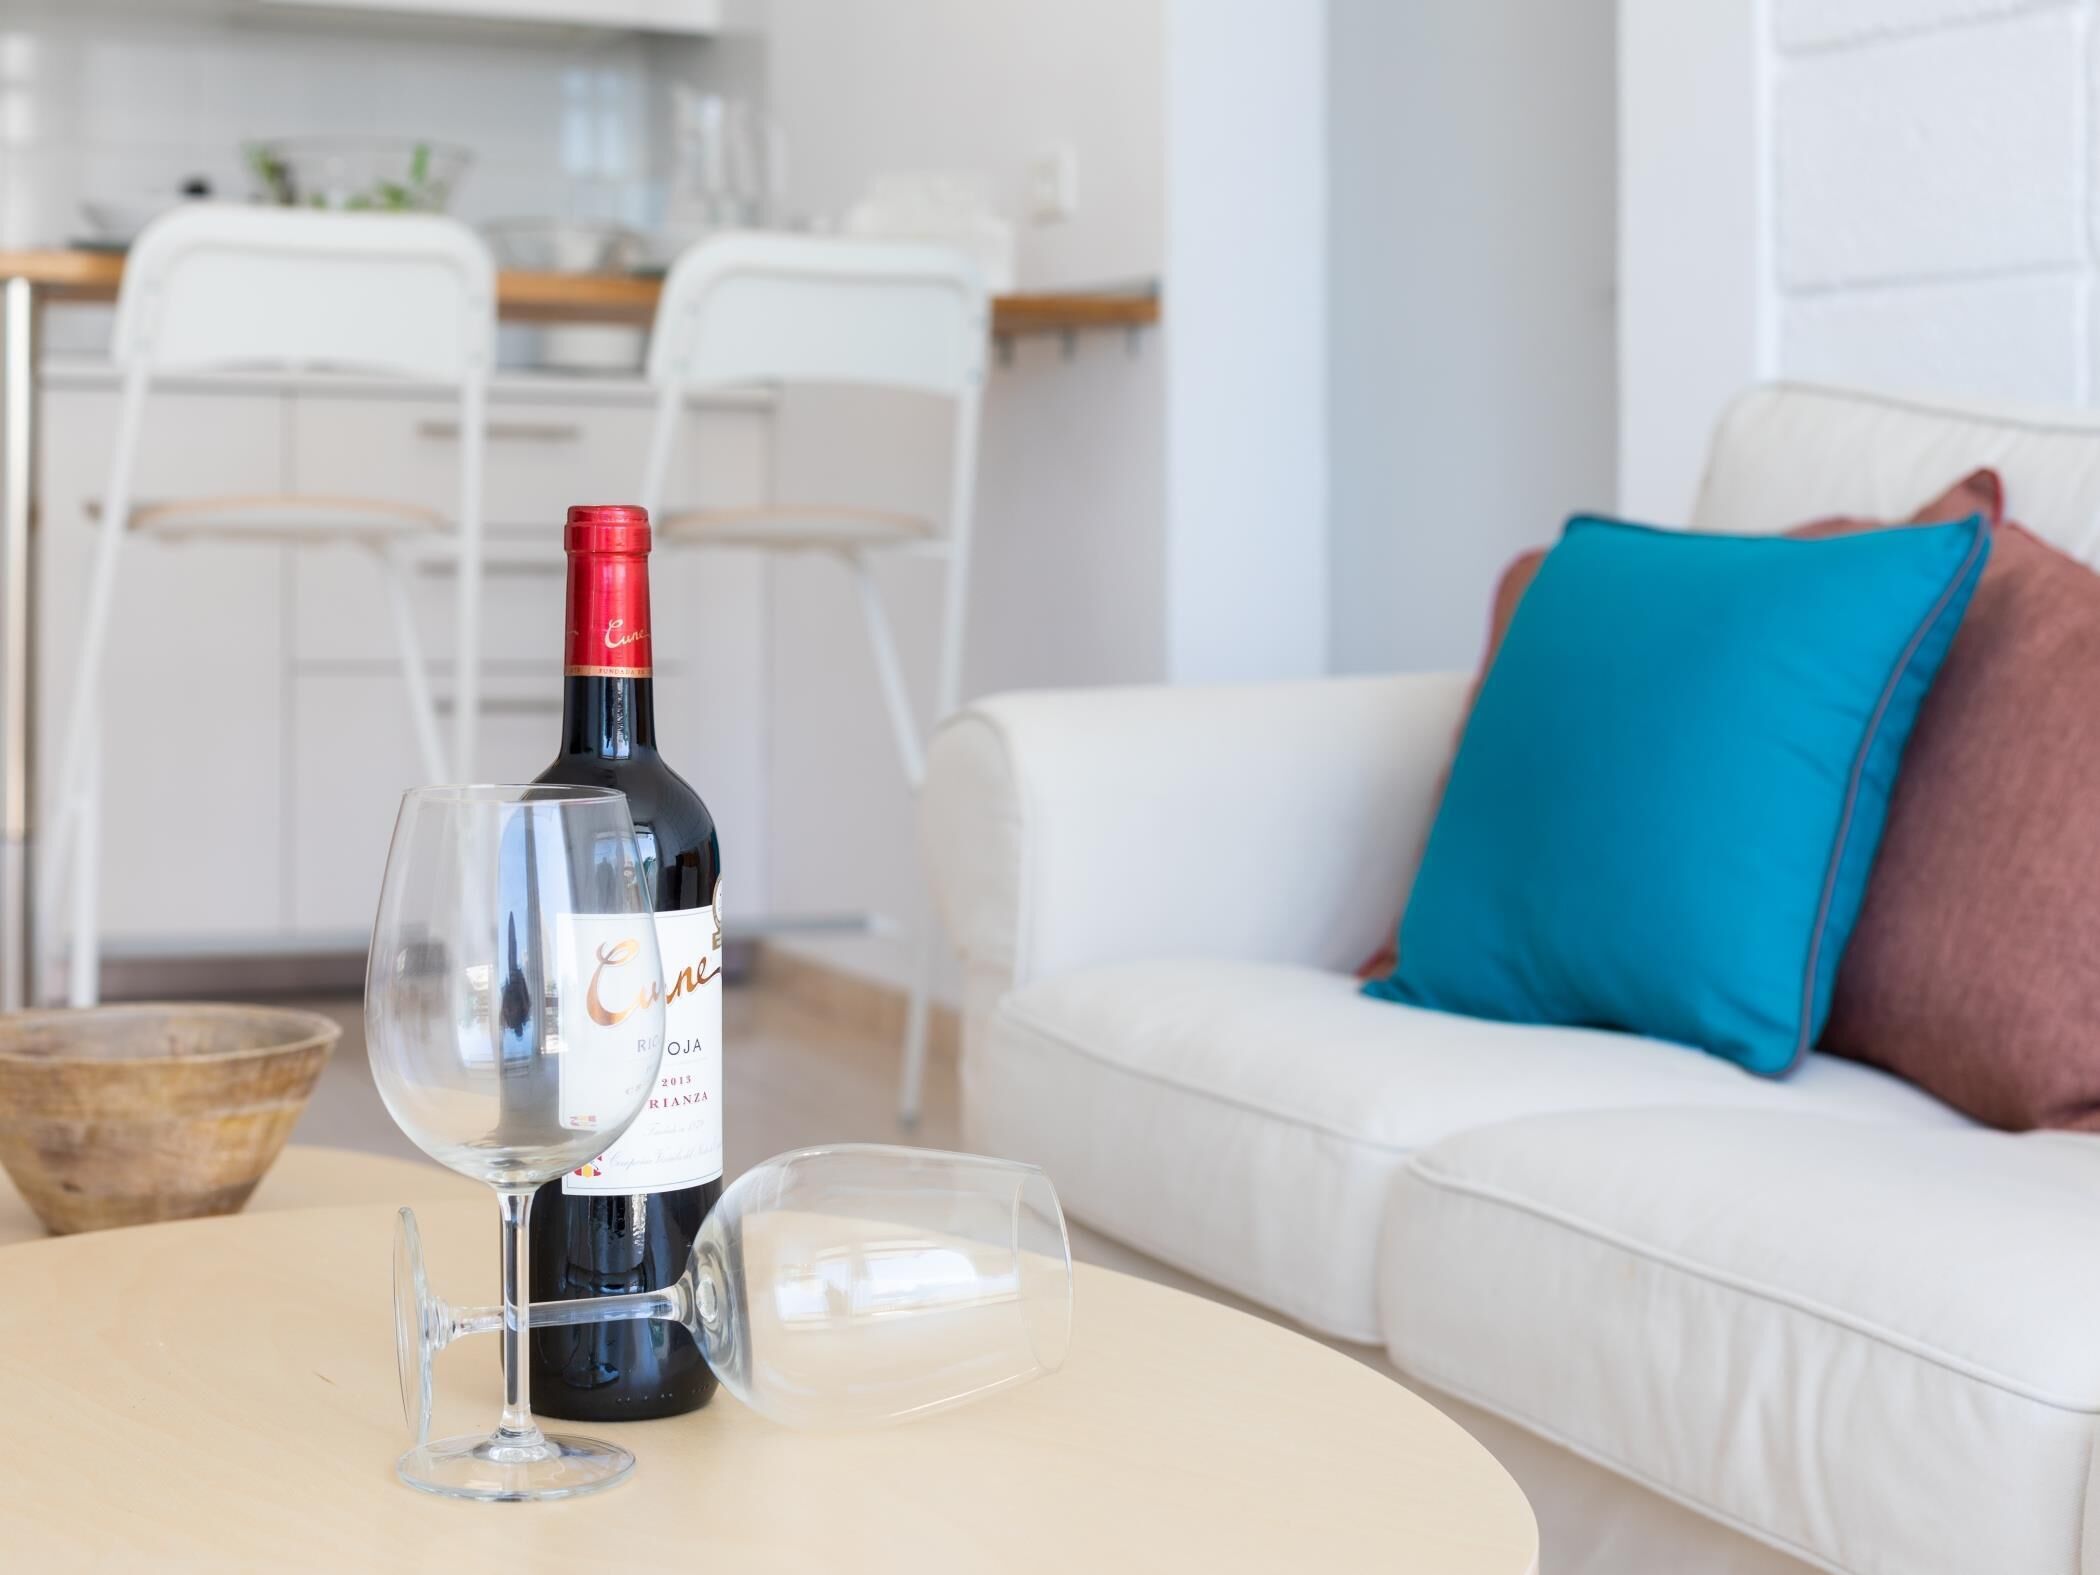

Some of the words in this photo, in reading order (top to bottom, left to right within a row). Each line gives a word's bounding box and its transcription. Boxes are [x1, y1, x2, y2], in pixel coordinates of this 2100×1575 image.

[604, 618, 650, 649] Cune
[586, 938, 721, 1027] Cune
[644, 1090, 708, 1109] RIANZA
